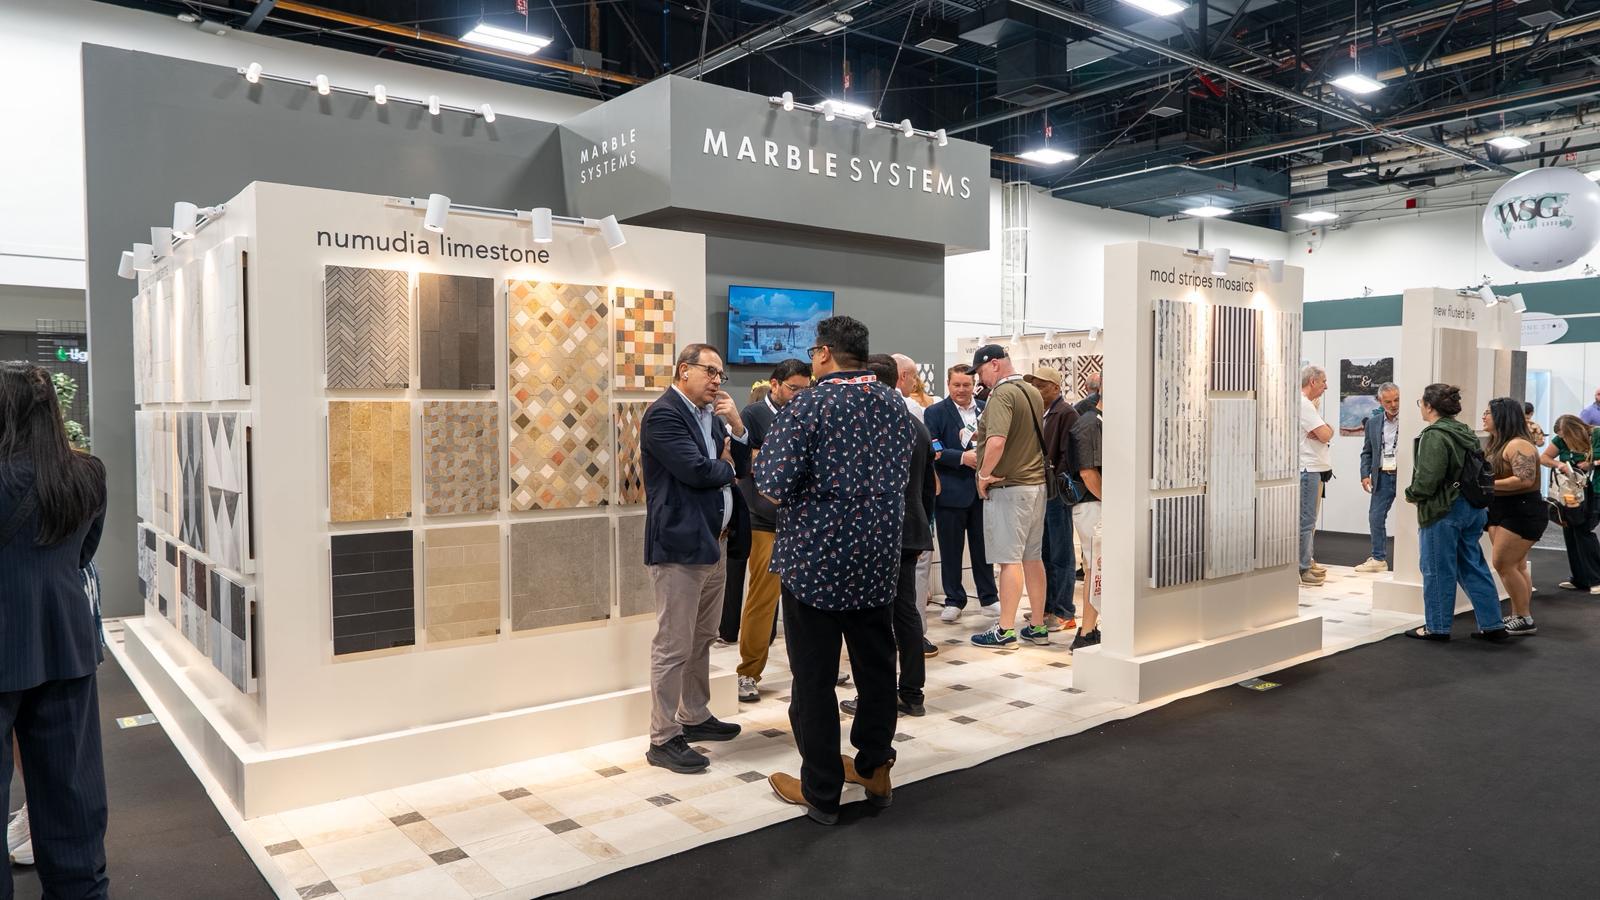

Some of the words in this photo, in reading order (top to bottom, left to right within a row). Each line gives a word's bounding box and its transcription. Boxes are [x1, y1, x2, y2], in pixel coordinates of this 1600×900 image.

[580, 128, 636, 164] MARBLE
[580, 150, 636, 184] SYSTEMS
[702, 128, 837, 177] MARBLE
[849, 157, 971, 199] SYSTEMS
[1496, 195, 1562, 225] WSG
[316, 230, 430, 255] numudia
[440, 234, 550, 264] limestone
[1150, 266, 1176, 284] mod
[1178, 270, 1213, 292] stripes
[1215, 276, 1254, 293] mosaics
[1433, 306, 1447, 317] new
[1039, 342, 1067, 351] aegean
[1068, 340, 1082, 349] red
[1361, 375, 1372, 388] &
